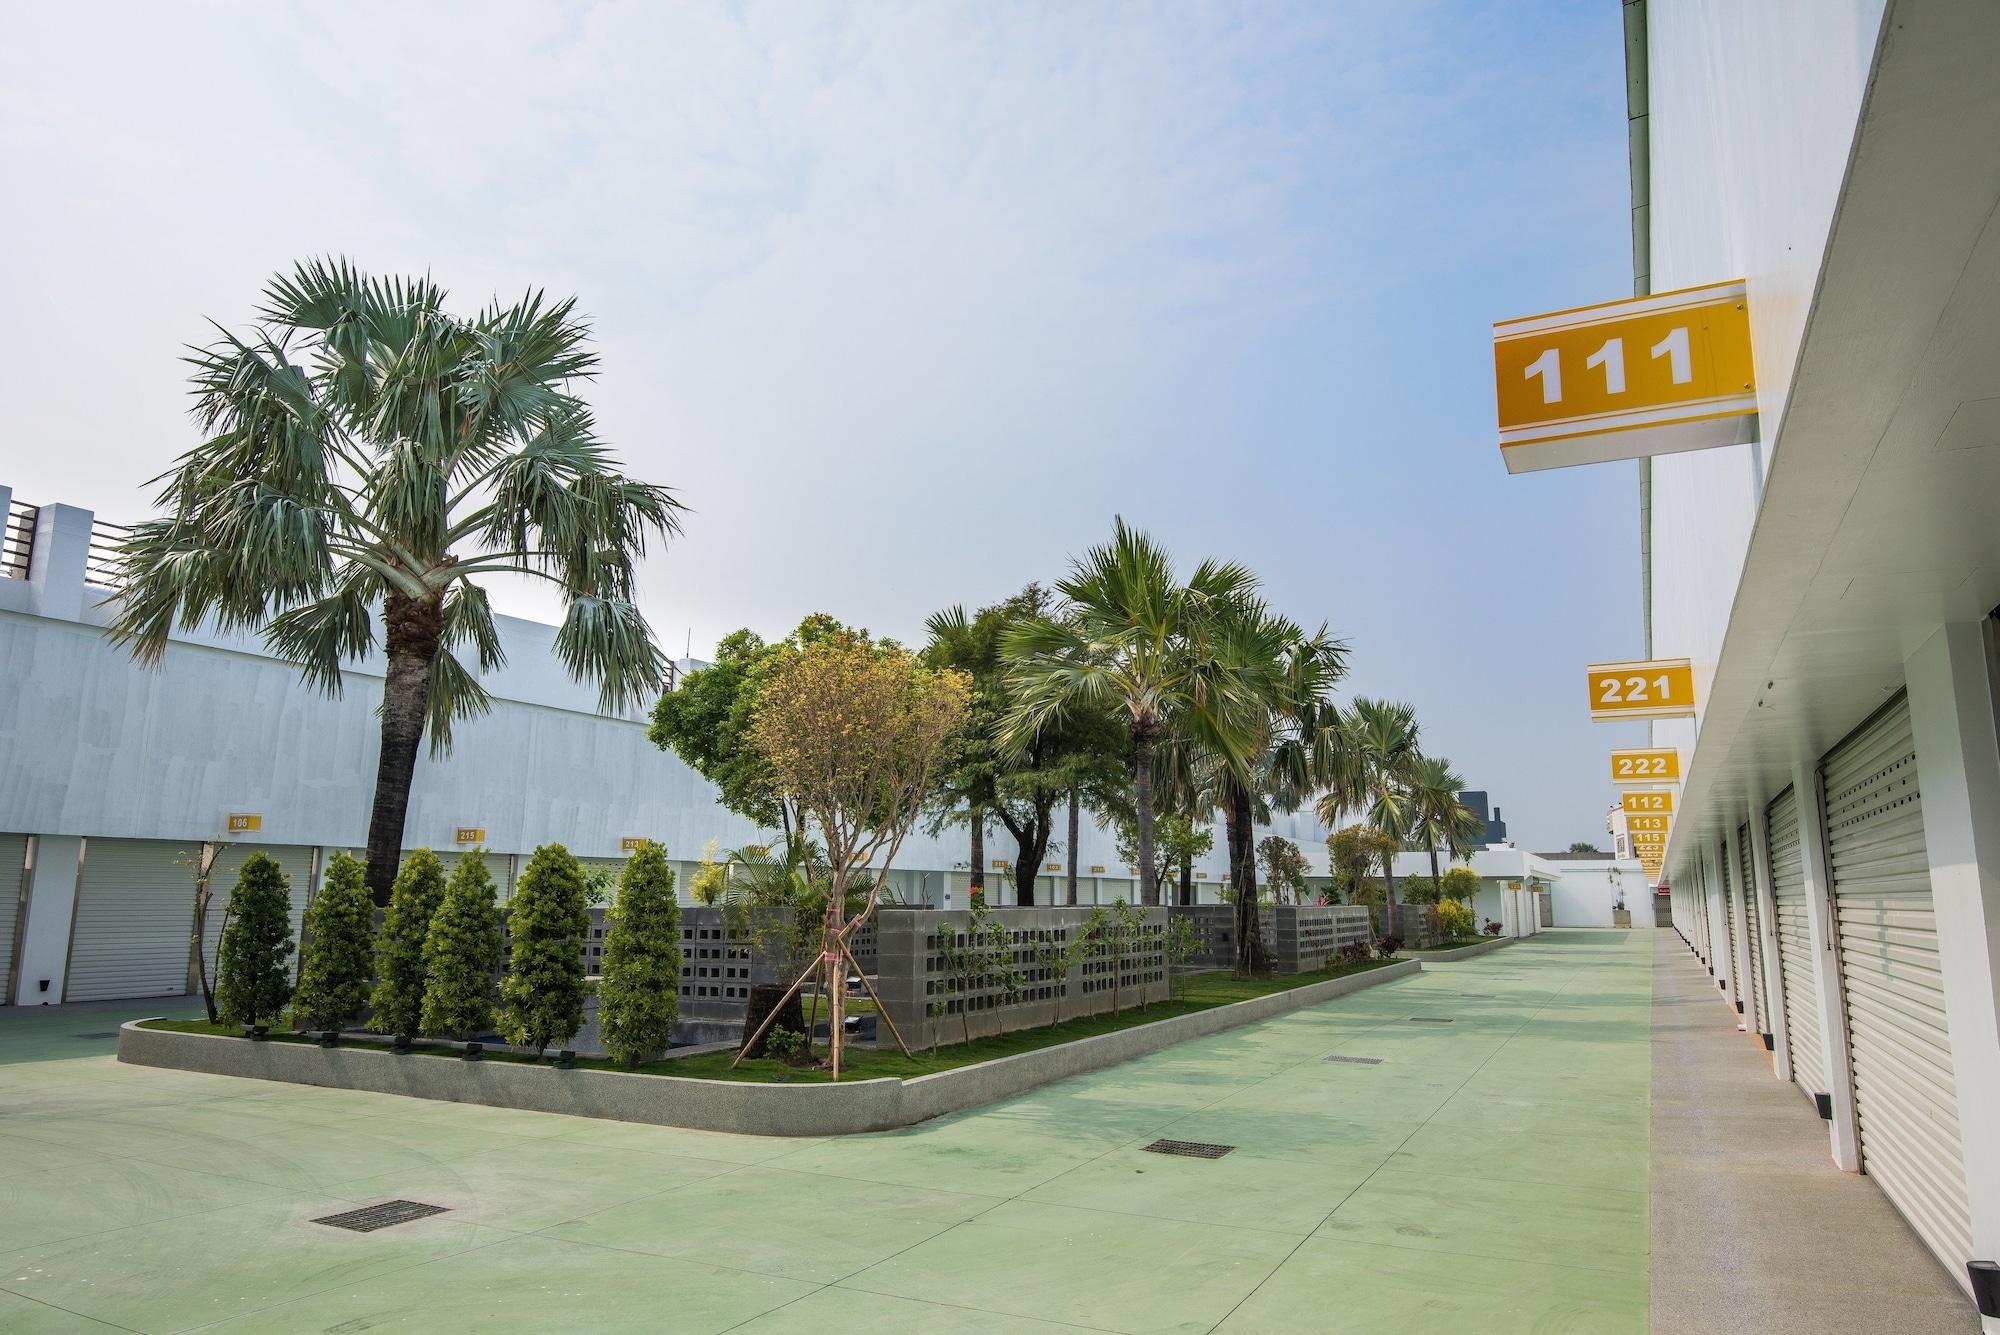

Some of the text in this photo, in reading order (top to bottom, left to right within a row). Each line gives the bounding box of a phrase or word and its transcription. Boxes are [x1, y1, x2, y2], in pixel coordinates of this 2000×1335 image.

[1523, 326, 1692, 404] 111
[1599, 674, 1670, 703] 221
[1618, 757, 1667, 775] 222
[1628, 796, 1663, 809] 112
[233, 818, 248, 827] 106
[1633, 819, 1661, 828] 113
[460, 831, 475, 840] 215
[1637, 833, 1660, 842] 115
